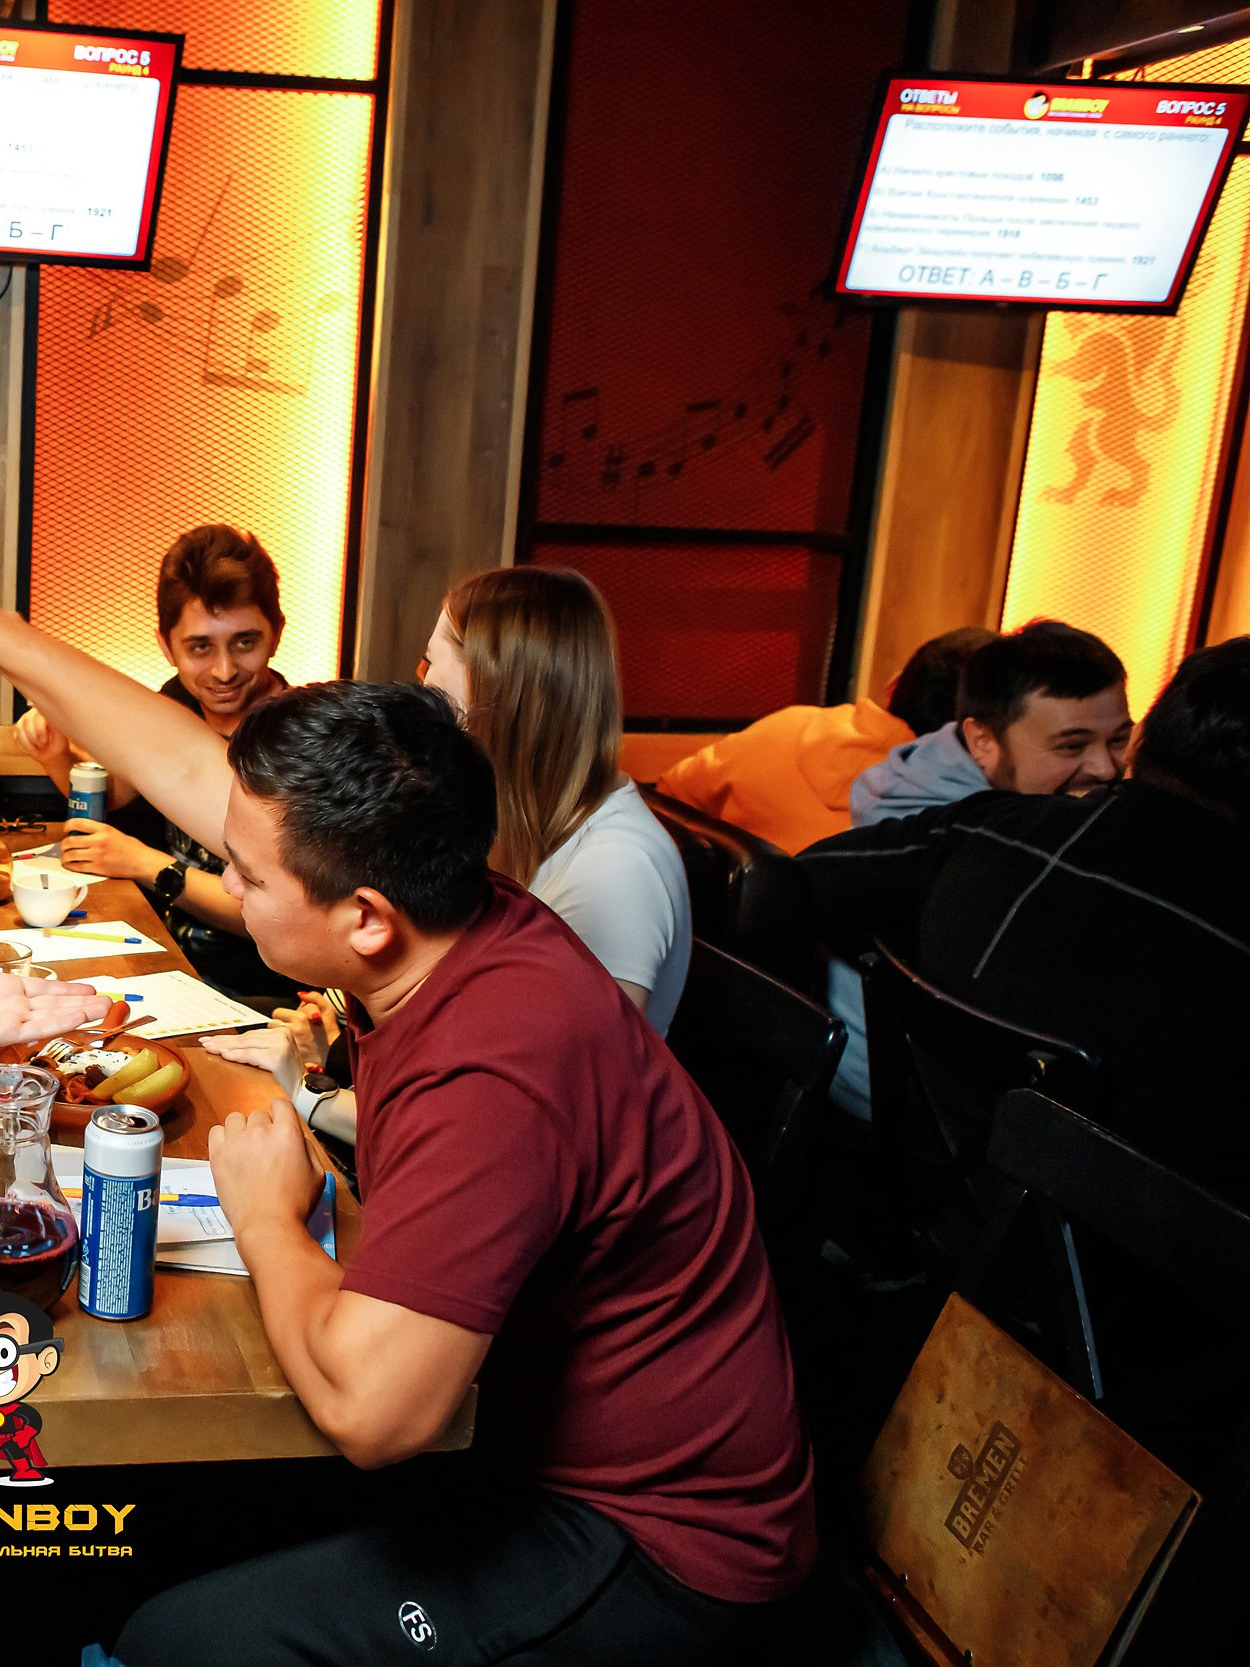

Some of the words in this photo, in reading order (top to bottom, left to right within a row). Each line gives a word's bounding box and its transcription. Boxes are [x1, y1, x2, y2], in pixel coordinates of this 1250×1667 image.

[74, 45, 138, 65] ВОПРОС
[900, 88, 959, 105] ОТВЕТЫ
[1156, 100, 1215, 116] ВОПРОС
[1216, 102, 1228, 116] 5
[86, 207, 113, 218] 1921
[9, 220, 24, 238] Б
[50, 224, 64, 240] Г
[898, 264, 977, 286] ОТВЕТ:
[1054, 271, 1071, 290] Б
[1092, 272, 1108, 291] Г
[952, 1431, 1015, 1539] BREMEN
[402, 1609, 432, 1642] FS
